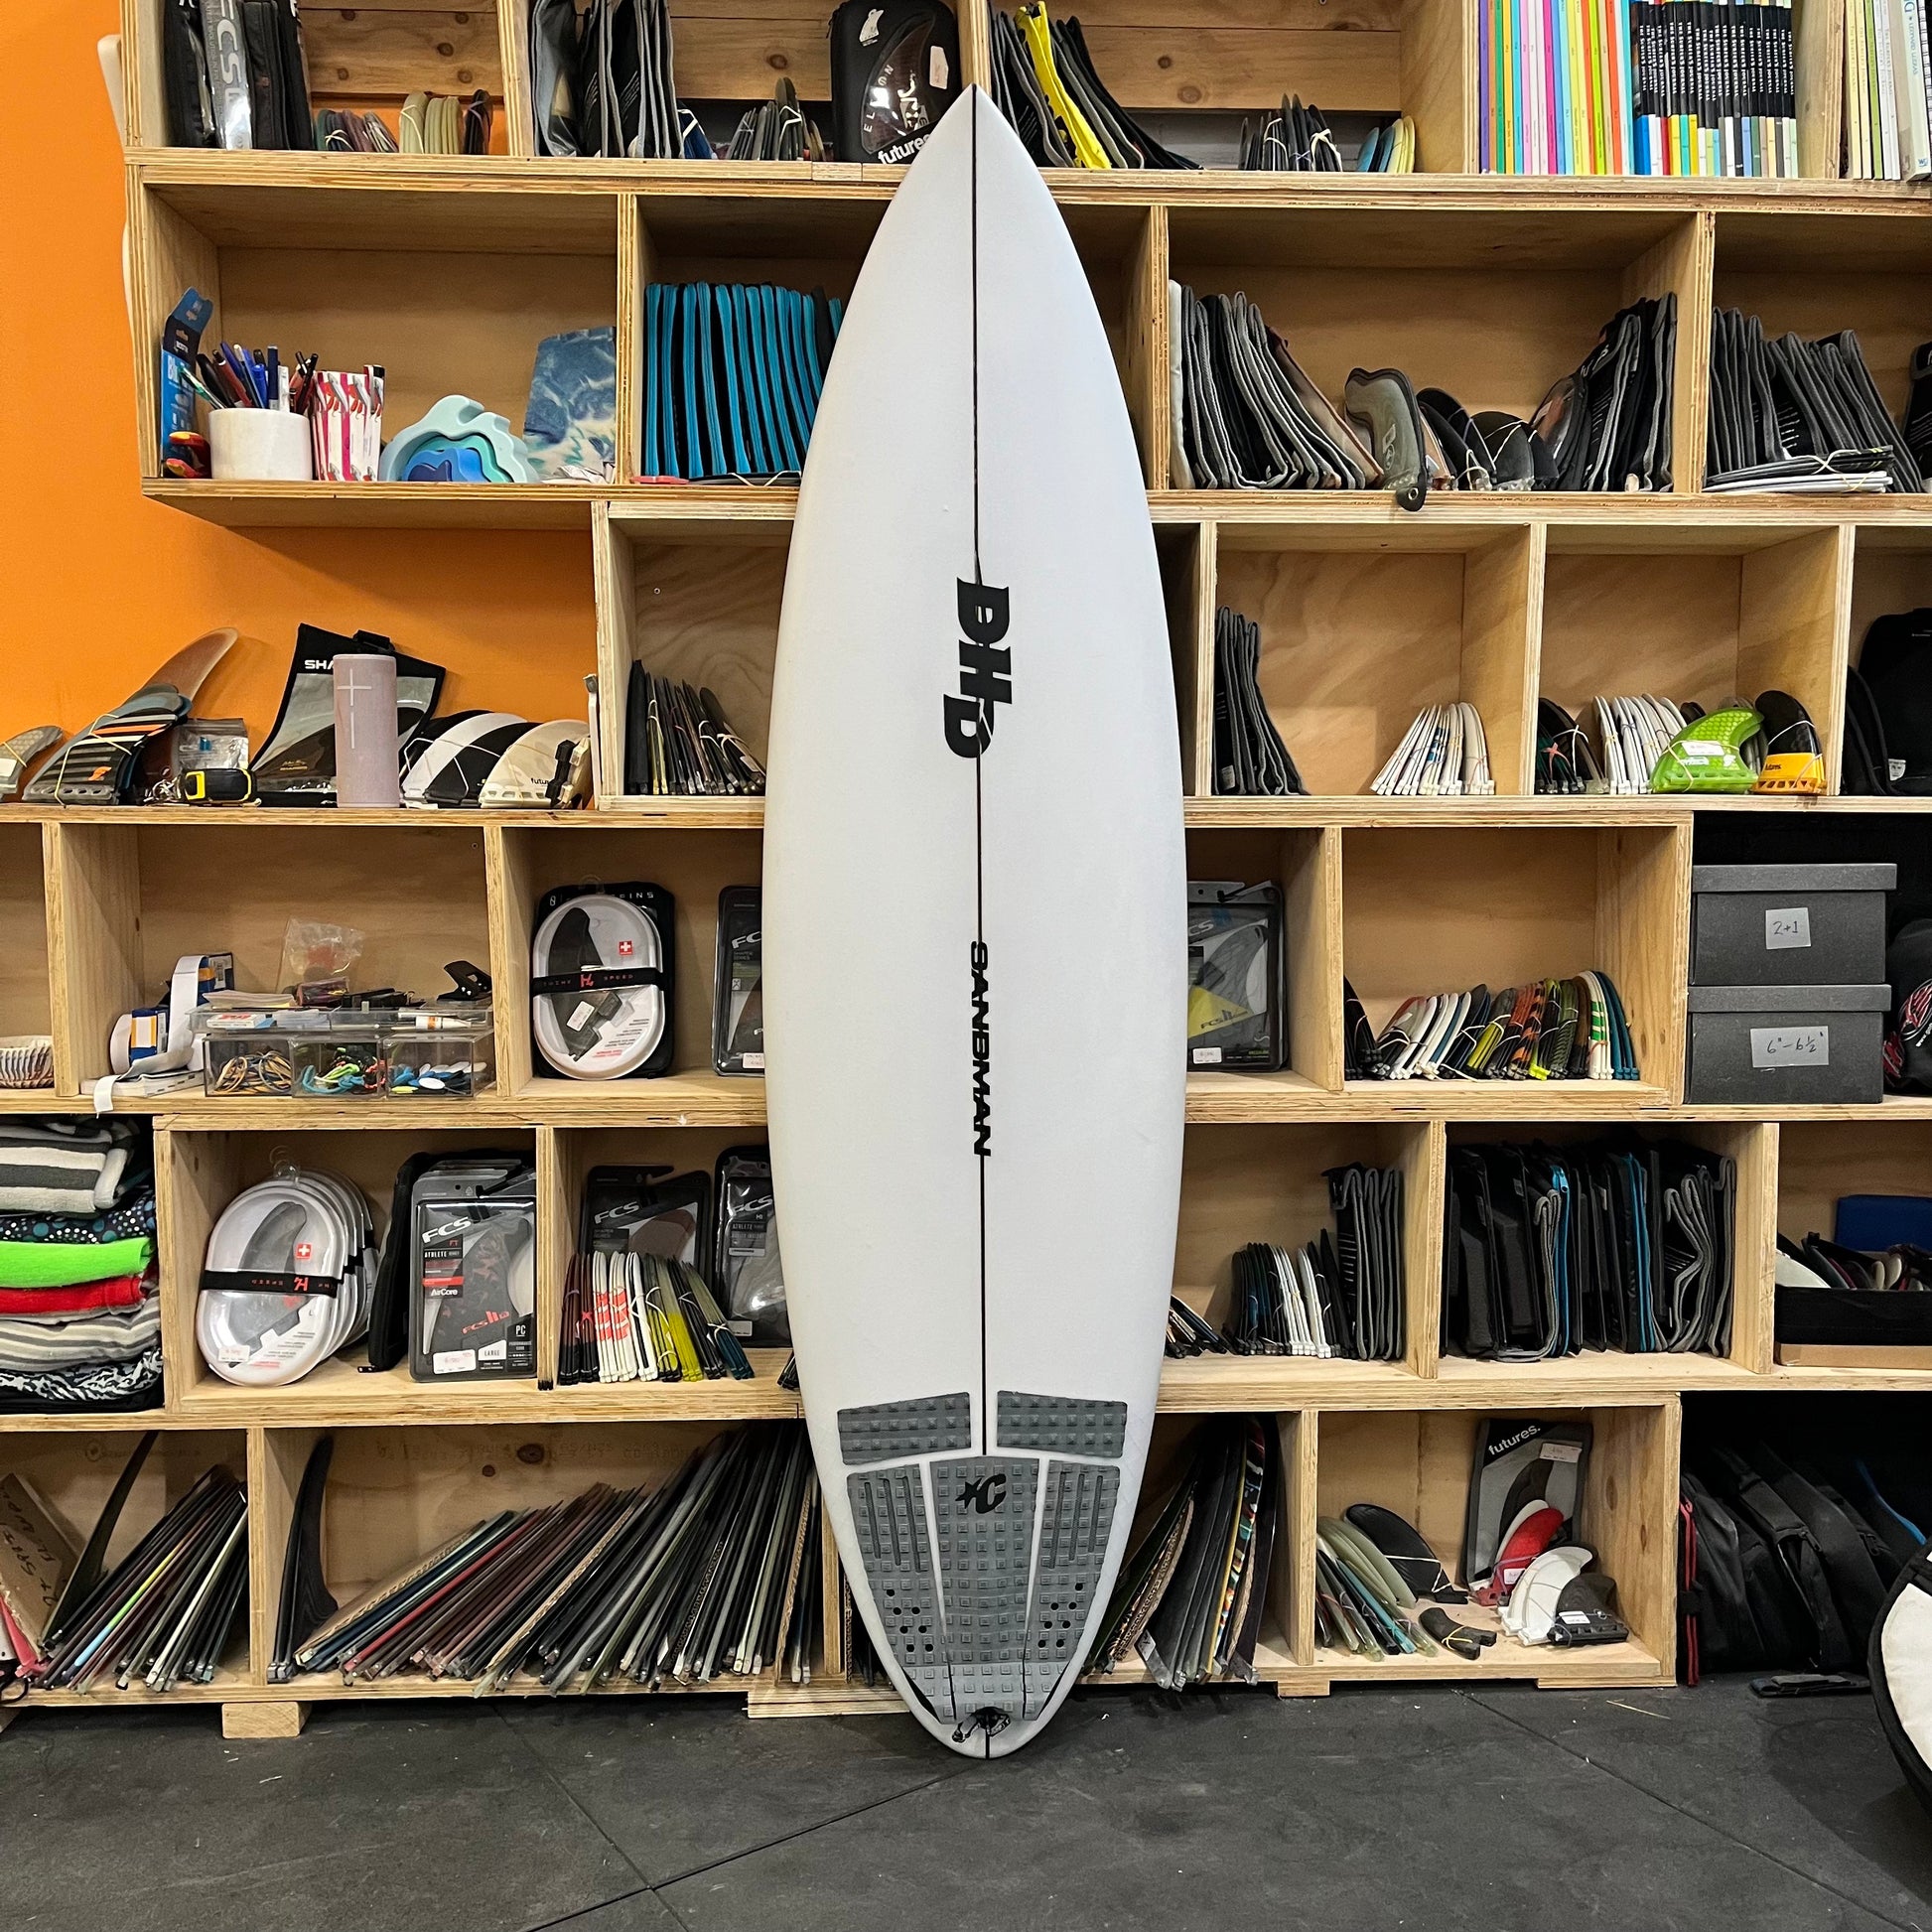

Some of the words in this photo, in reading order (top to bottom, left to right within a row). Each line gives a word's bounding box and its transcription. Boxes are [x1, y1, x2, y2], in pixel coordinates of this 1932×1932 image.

[943, 577, 1013, 759] DHD
[1188, 919, 1214, 936] CS
[1772, 920, 1798, 935] 2+1
[594, 1201, 640, 1224] FCS
[730, 1194, 773, 1217] FCS
[422, 1216, 472, 1243] FCS
[515, 1324, 526, 1335] PC
